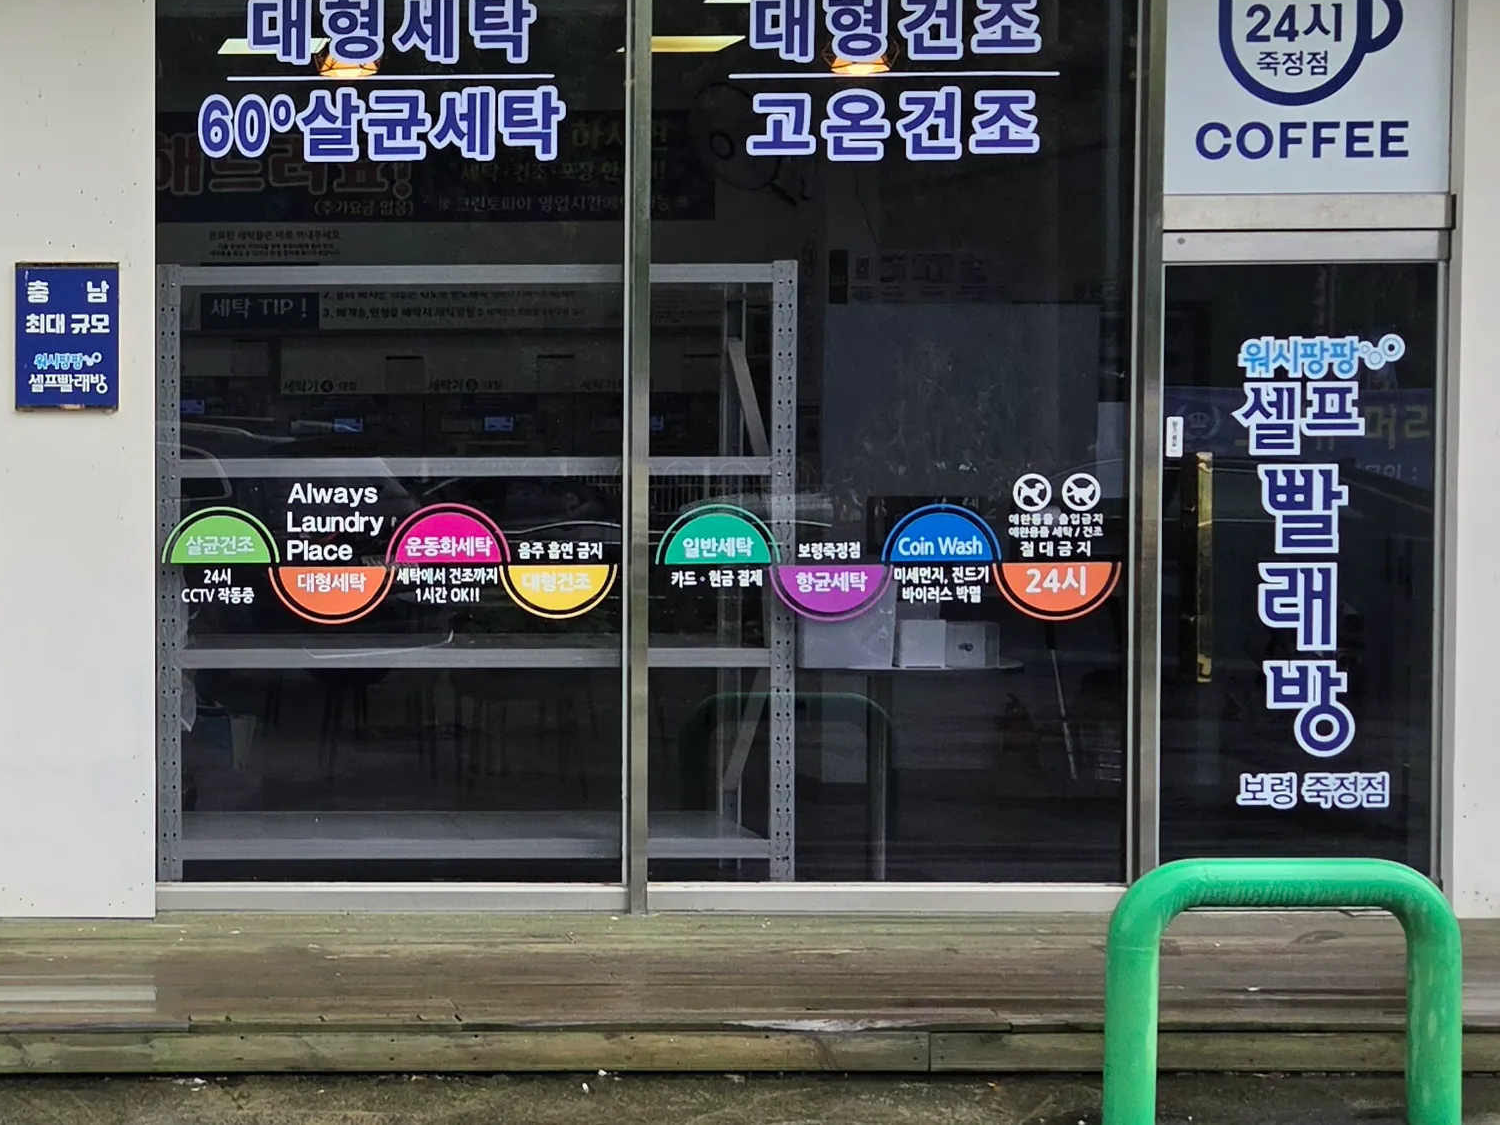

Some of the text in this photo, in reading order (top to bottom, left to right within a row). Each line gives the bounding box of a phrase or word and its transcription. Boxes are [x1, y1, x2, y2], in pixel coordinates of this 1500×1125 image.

[1245, 3, 1343, 43] 24시
[1256, 50, 1328, 76] 죽정점
[746, 86, 1040, 161] 고온건조
[1194, 120, 1410, 160] COFFEE
[25, 313, 110, 334] 최대 규모
[34, 352, 84, 370] 워시팡팡
[1238, 336, 1362, 378] 워시팡팡
[28, 373, 108, 394] 셀프빨래방
[287, 482, 379, 507] Always
[286, 511, 385, 536] Laundry
[186, 535, 255, 556] 살균건조
[286, 539, 354, 562] Place
[405, 535, 494, 557] 운동화세탁
[518, 541, 604, 560] 음주 흡연 금지
[682, 536, 755, 558] 일반세탁
[798, 541, 862, 560] 보령죽정점
[899, 534, 984, 557] Coin Wash
[203, 567, 232, 585] 24시
[297, 571, 368, 593] 대형세탁
[396, 566, 499, 585] 세탁에서 건조까지
[521, 571, 592, 593] 대형건조
[671, 570, 697, 588] 카드
[708, 569, 734, 588] 현금
[737, 568, 763, 587] 결제
[795, 571, 869, 593] 항균세탁
[952, 565, 990, 584] 진드기
[1025, 564, 1088, 596] 24시
[181, 586, 255, 605] CCTV 작동중
[415, 585, 448, 604] 1시간
[902, 584, 982, 604] 바이러스 박멸
[1236, 771, 1391, 809] 보령 죽정점
